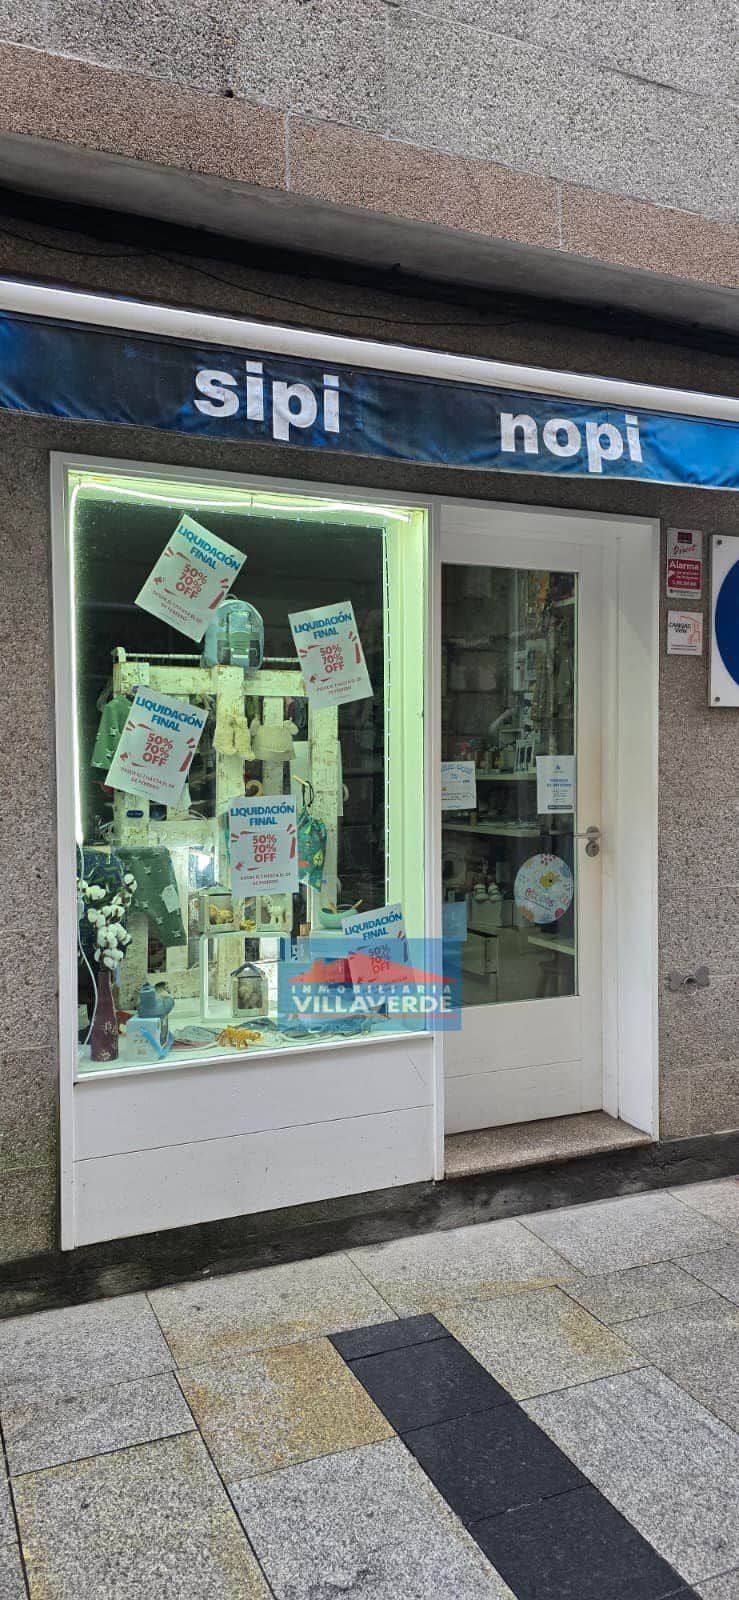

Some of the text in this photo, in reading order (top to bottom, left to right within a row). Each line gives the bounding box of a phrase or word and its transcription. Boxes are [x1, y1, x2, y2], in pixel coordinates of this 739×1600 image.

[193, 360, 642, 473] sipi nopi
[178, 524, 240, 570] LIQUIDACIÓN
[190, 546, 216, 569] FINAL
[183, 562, 208, 584] 50%
[176, 582, 201, 599] OFF
[180, 573, 204, 594] 70%
[294, 610, 352, 633] LIQUIDACIÓN
[313, 627, 339, 639] FINAL
[320, 643, 342, 656] 50%
[322, 653, 343, 665] 70%
[324, 662, 344, 674] OFF
[136, 697, 204, 729] LIQUIDACIÓN
[151, 714, 180, 732] FINAL
[148, 733, 173, 750] 50%
[145, 742, 169, 759] 70%
[143, 752, 167, 767] OFF
[230, 801, 295, 817] LIQUIDACIÓN
[249, 817, 277, 826] FINAL
[253, 833, 277, 844] 50%
[254, 843, 277, 854] 70%
[255, 852, 277, 863] OFF
[345, 911, 403, 935] LIQUIDACIÓN
[363, 927, 389, 940] FINAL
[373, 961, 390, 974] OFF
